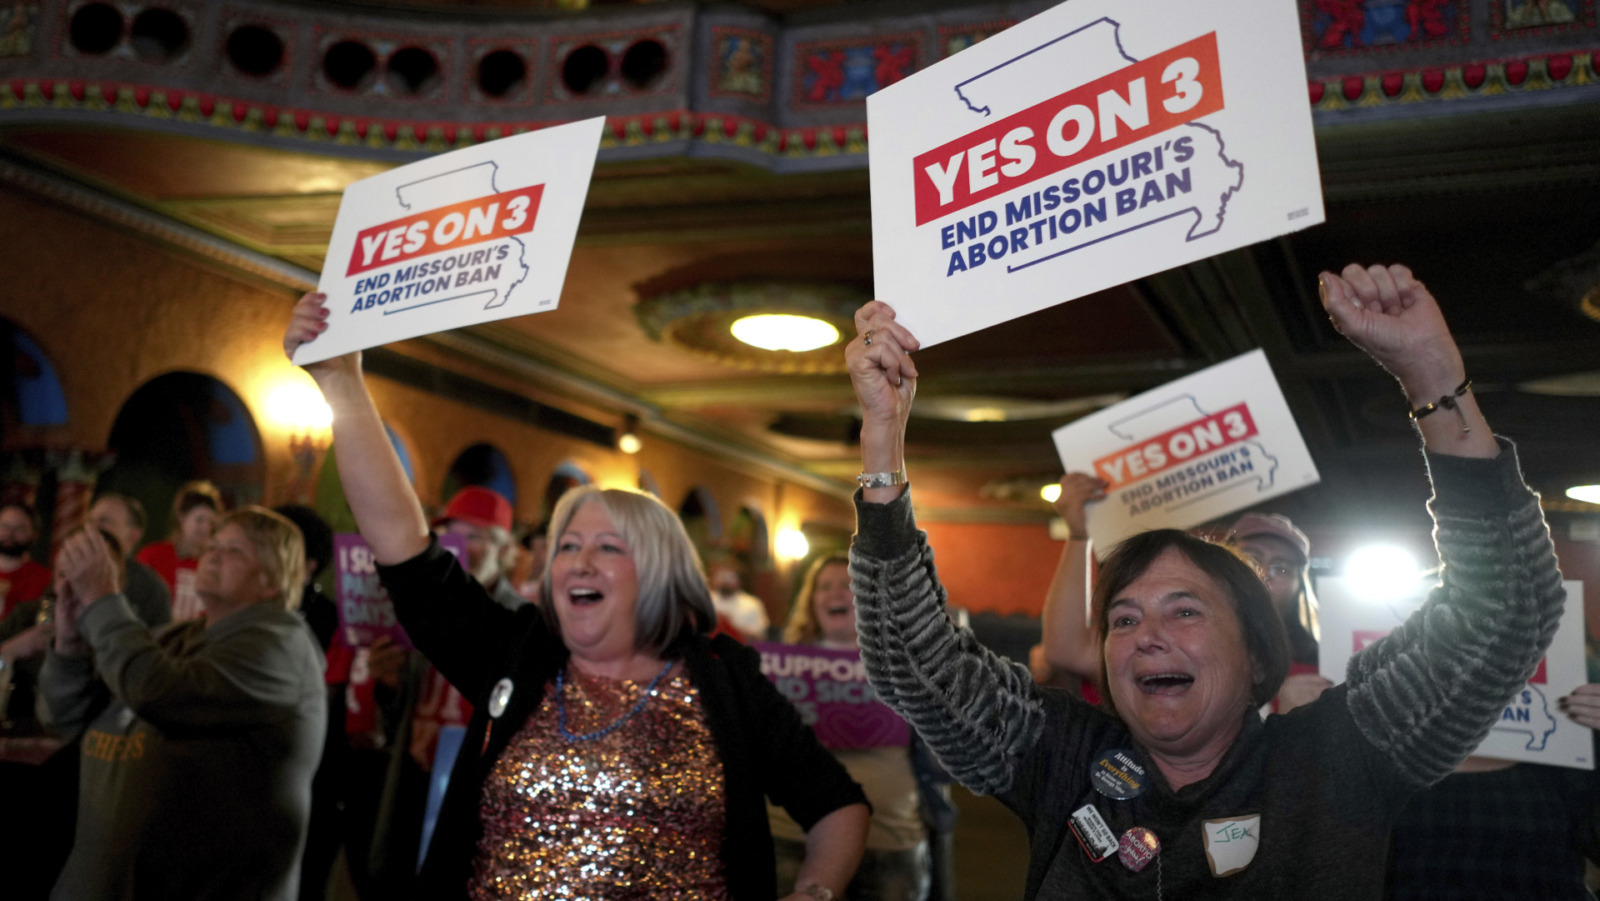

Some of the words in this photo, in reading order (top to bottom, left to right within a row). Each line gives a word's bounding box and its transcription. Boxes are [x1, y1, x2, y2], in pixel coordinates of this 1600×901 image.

[924, 126, 1036, 206] YES
[1045, 76, 1151, 157] ON
[1160, 56, 1204, 114] 3
[940, 211, 998, 250] END
[1004, 136, 1195, 228] MISSOURI'S
[361, 220, 430, 266] YES
[433, 201, 500, 246] ON
[502, 196, 530, 230] 3
[946, 196, 1107, 278] ABORTION
[1116, 167, 1193, 217] BAN
[350, 280, 452, 314] ABORTION
[454, 264, 502, 288] BAN
[354, 272, 390, 296] END
[393, 244, 510, 282] MISSOURI'S
[1103, 443, 1165, 484] YES
[1168, 422, 1224, 458] ON
[1223, 411, 1248, 438] 3
[1120, 483, 1154, 505] END
[1129, 478, 1214, 517] ABORTION
[1218, 461, 1254, 484] BAN
[1502, 708, 1530, 722] AN
[1100, 759, 1140, 789] Everything
[1114, 752, 1145, 775] Attitude
